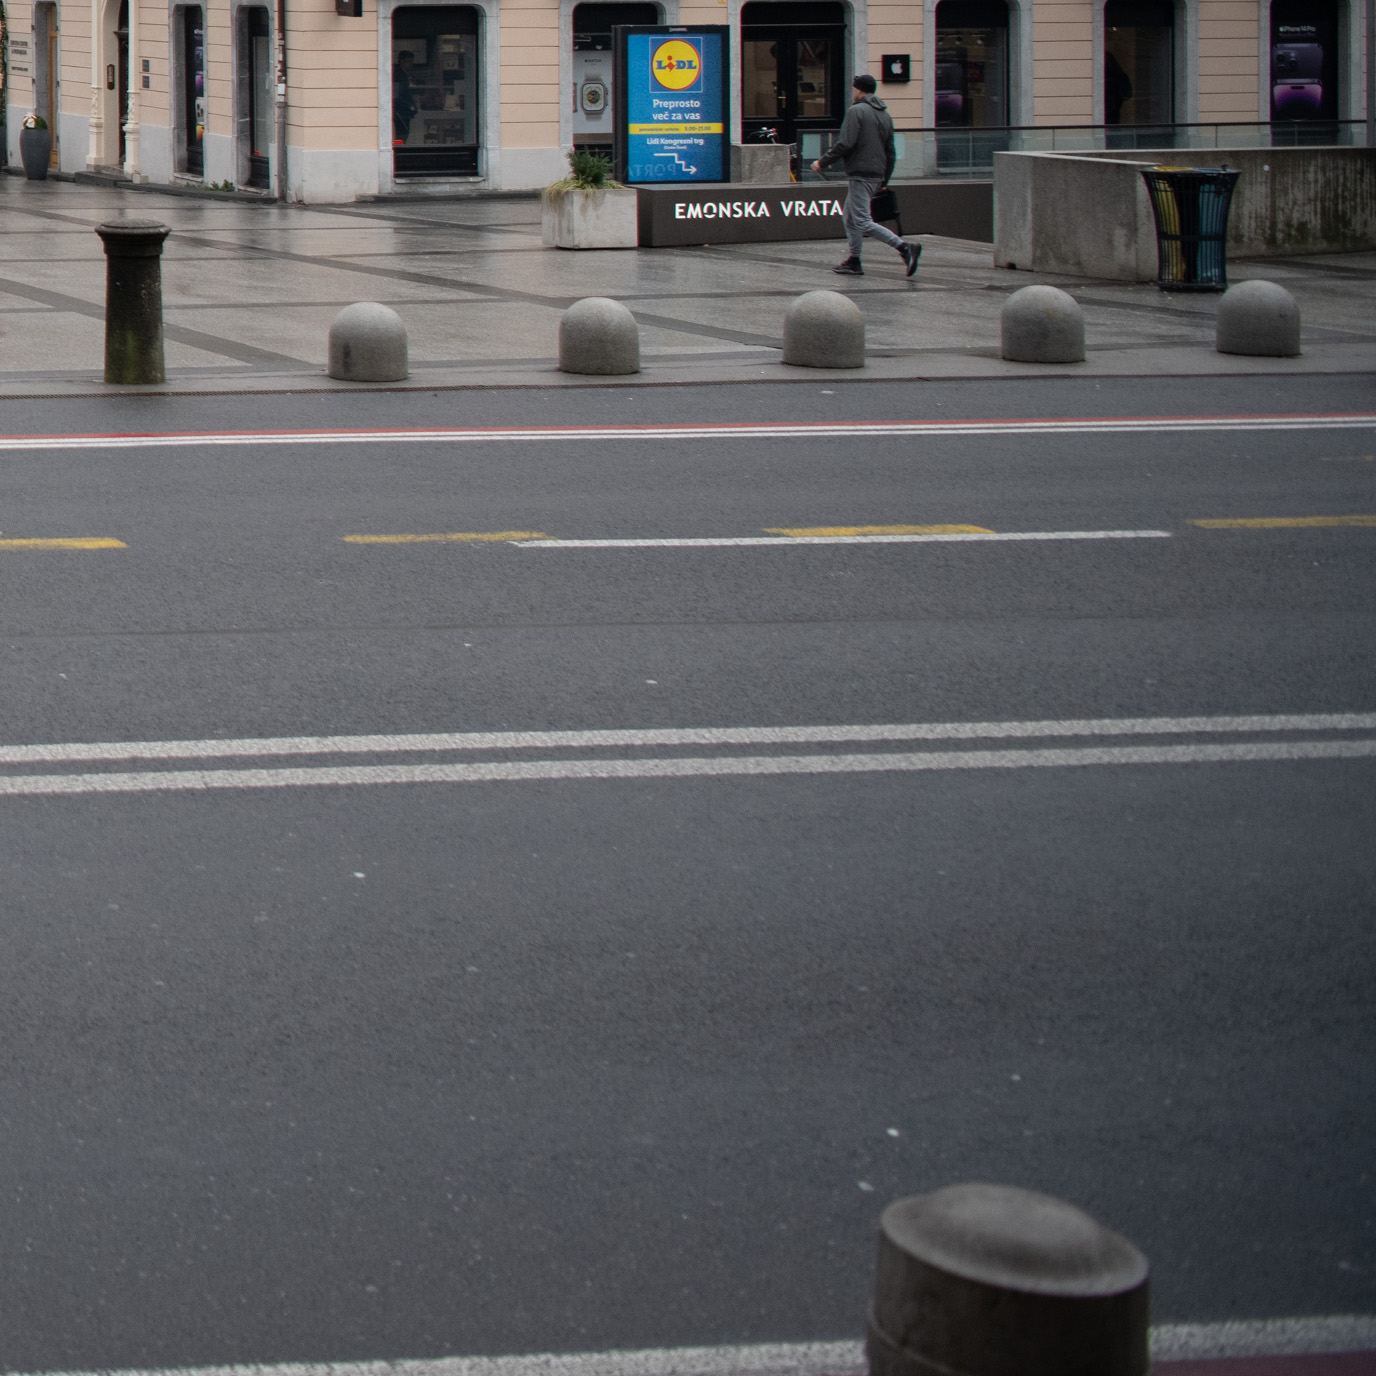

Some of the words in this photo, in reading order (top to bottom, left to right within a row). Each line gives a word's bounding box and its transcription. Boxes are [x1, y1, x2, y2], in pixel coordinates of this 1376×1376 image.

[652, 99, 701, 110] Preprosto
[652, 111, 669, 120] več
[684, 112, 701, 120] vas
[647, 137, 659, 145] Lidl
[660, 137, 693, 146] Kongresni
[694, 137, 704, 146] trg
[674, 201, 771, 219] EMONSKA
[780, 199, 844, 217] VRATA
